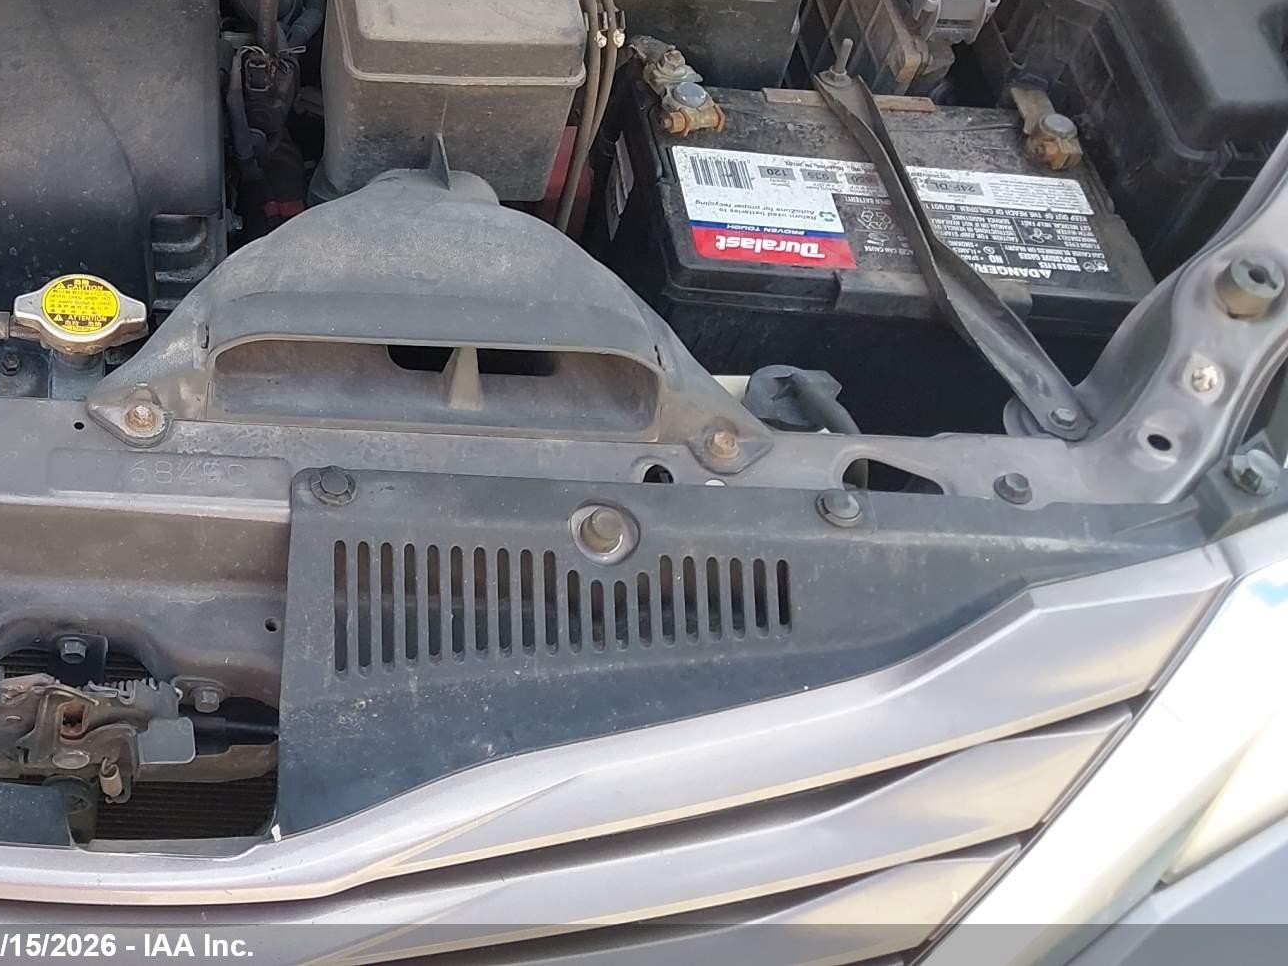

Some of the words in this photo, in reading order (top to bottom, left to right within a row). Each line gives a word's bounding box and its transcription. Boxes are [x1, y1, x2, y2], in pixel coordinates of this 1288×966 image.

[766, 168, 788, 177] 120
[695, 200, 732, 209] recycling
[734, 202, 761, 210] proper
[729, 208, 765, 217] batteries
[775, 207, 815, 216] AutoZone
[726, 224, 760, 232] TOUGH
[763, 227, 805, 236] PROVEN
[715, 235, 826, 259] Duralast
[863, 245, 884, 253] CAUSE
[1018, 252, 1041, 261] GASES
[1071, 250, 1091, 258] CAUSE
[988, 255, 1004, 264] NO
[1041, 255, 1077, 264] EXPLOSIVE
[1038, 261, 1057, 270] EYES
[68, 314, 107, 322] ATTENTION
